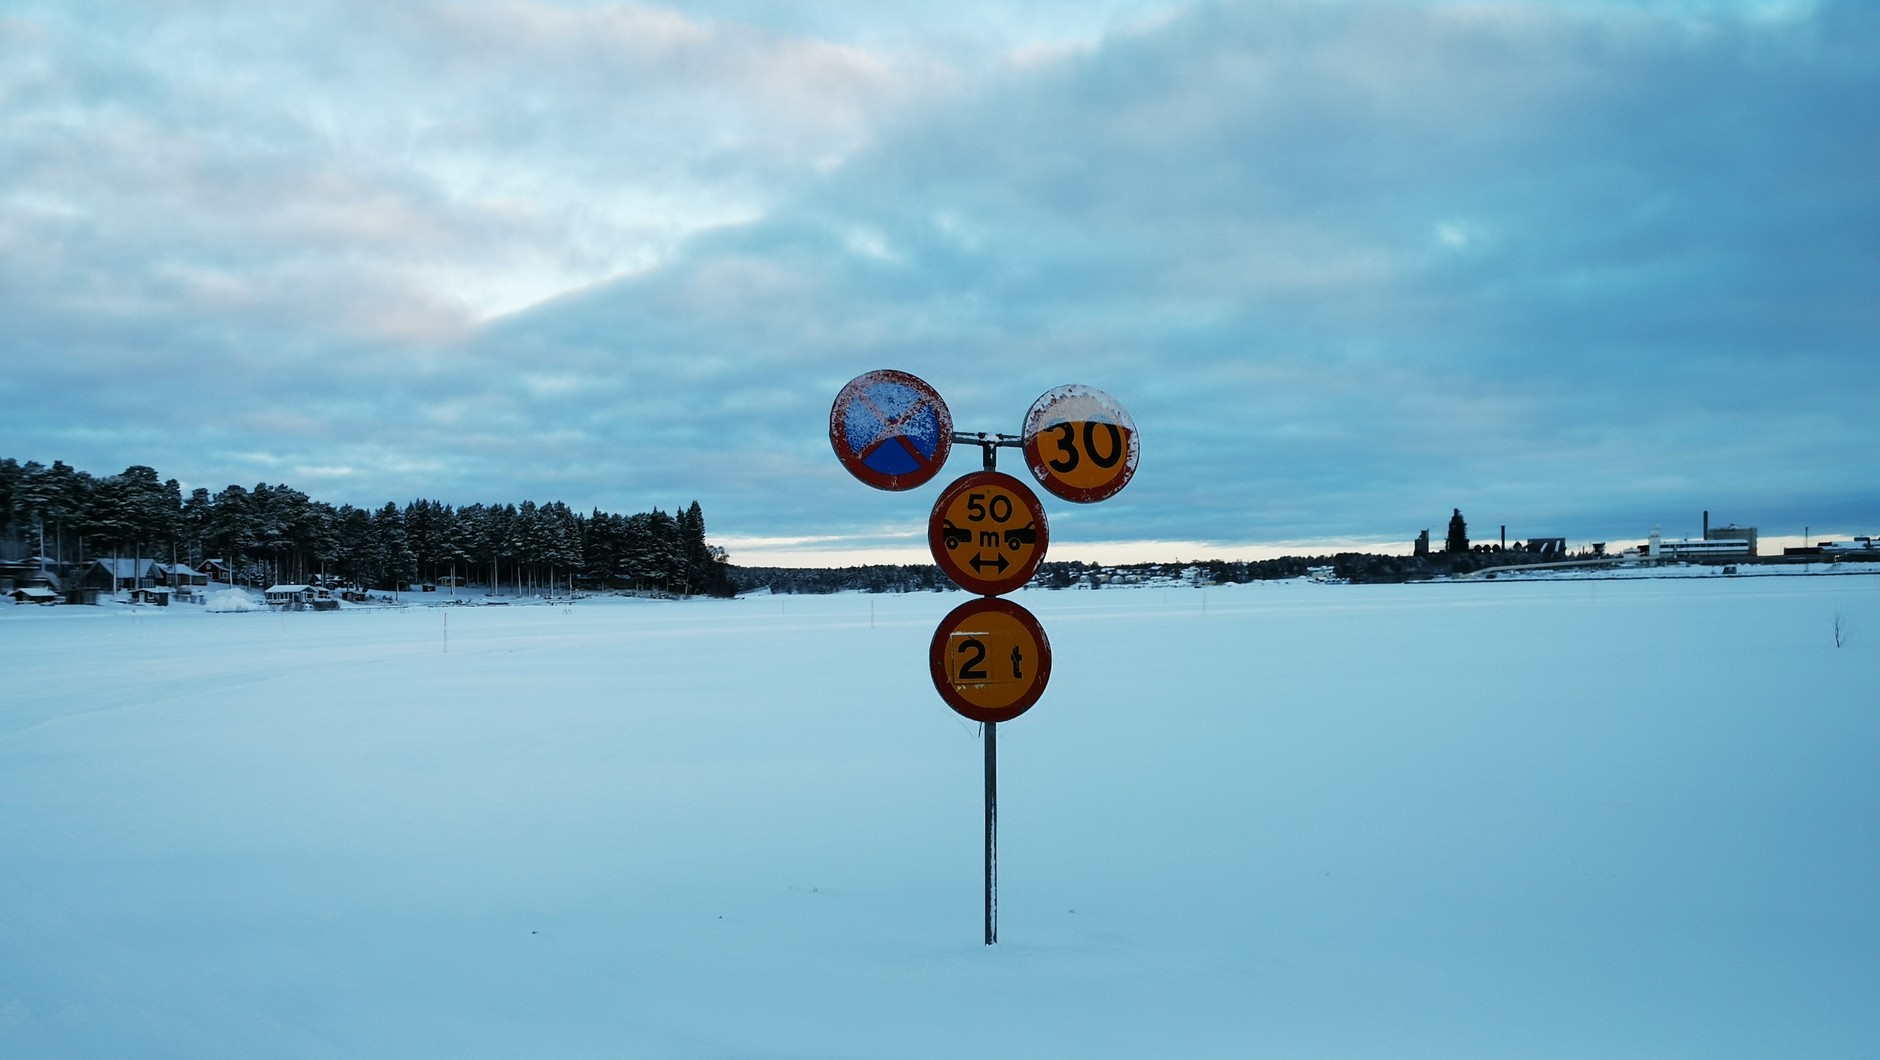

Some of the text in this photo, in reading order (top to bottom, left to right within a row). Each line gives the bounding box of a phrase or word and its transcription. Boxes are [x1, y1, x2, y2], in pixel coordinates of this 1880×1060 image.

[1044, 418, 1121, 473] 30
[967, 493, 1013, 523] 50
[980, 531, 1000, 547] m
[957, 638, 1022, 679] 2 t
